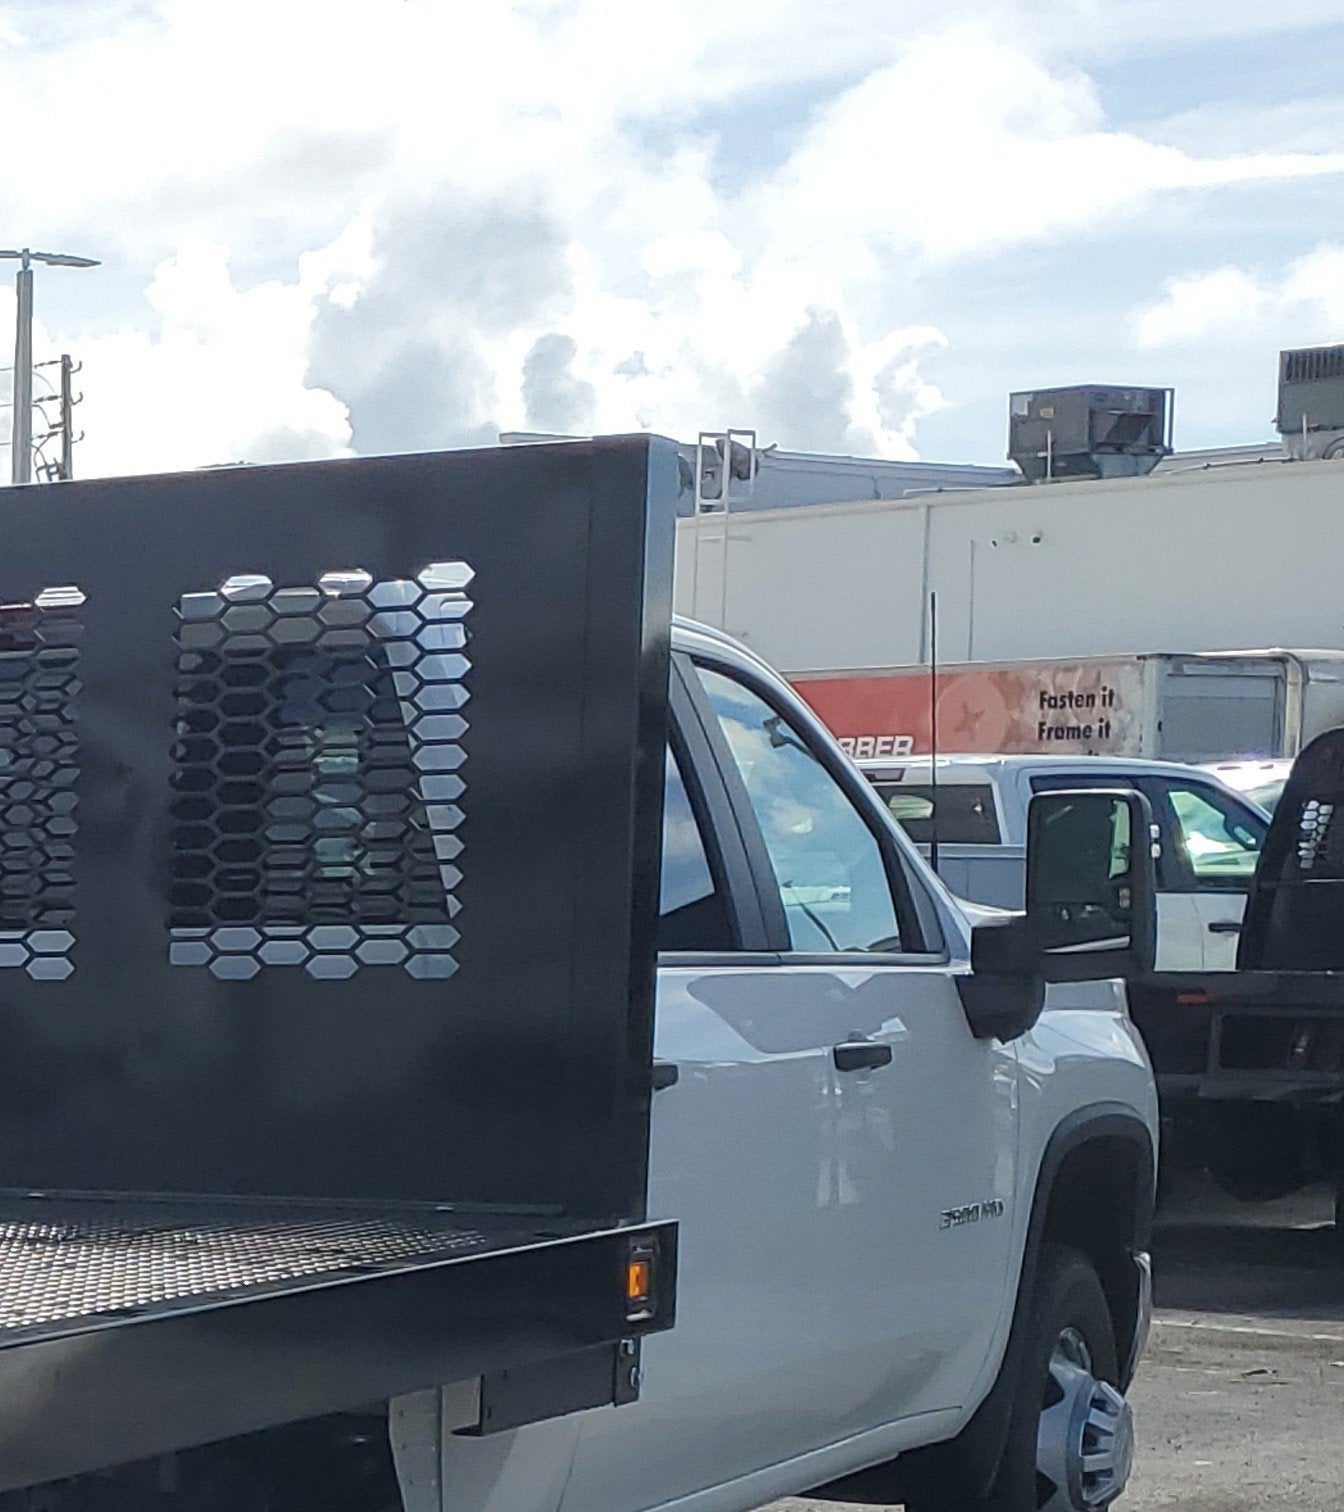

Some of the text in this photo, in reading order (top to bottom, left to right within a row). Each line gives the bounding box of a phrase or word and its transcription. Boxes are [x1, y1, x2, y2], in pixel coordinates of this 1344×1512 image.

[1039, 686, 1115, 710] Fasten it
[1037, 717, 1111, 741] Frame it
